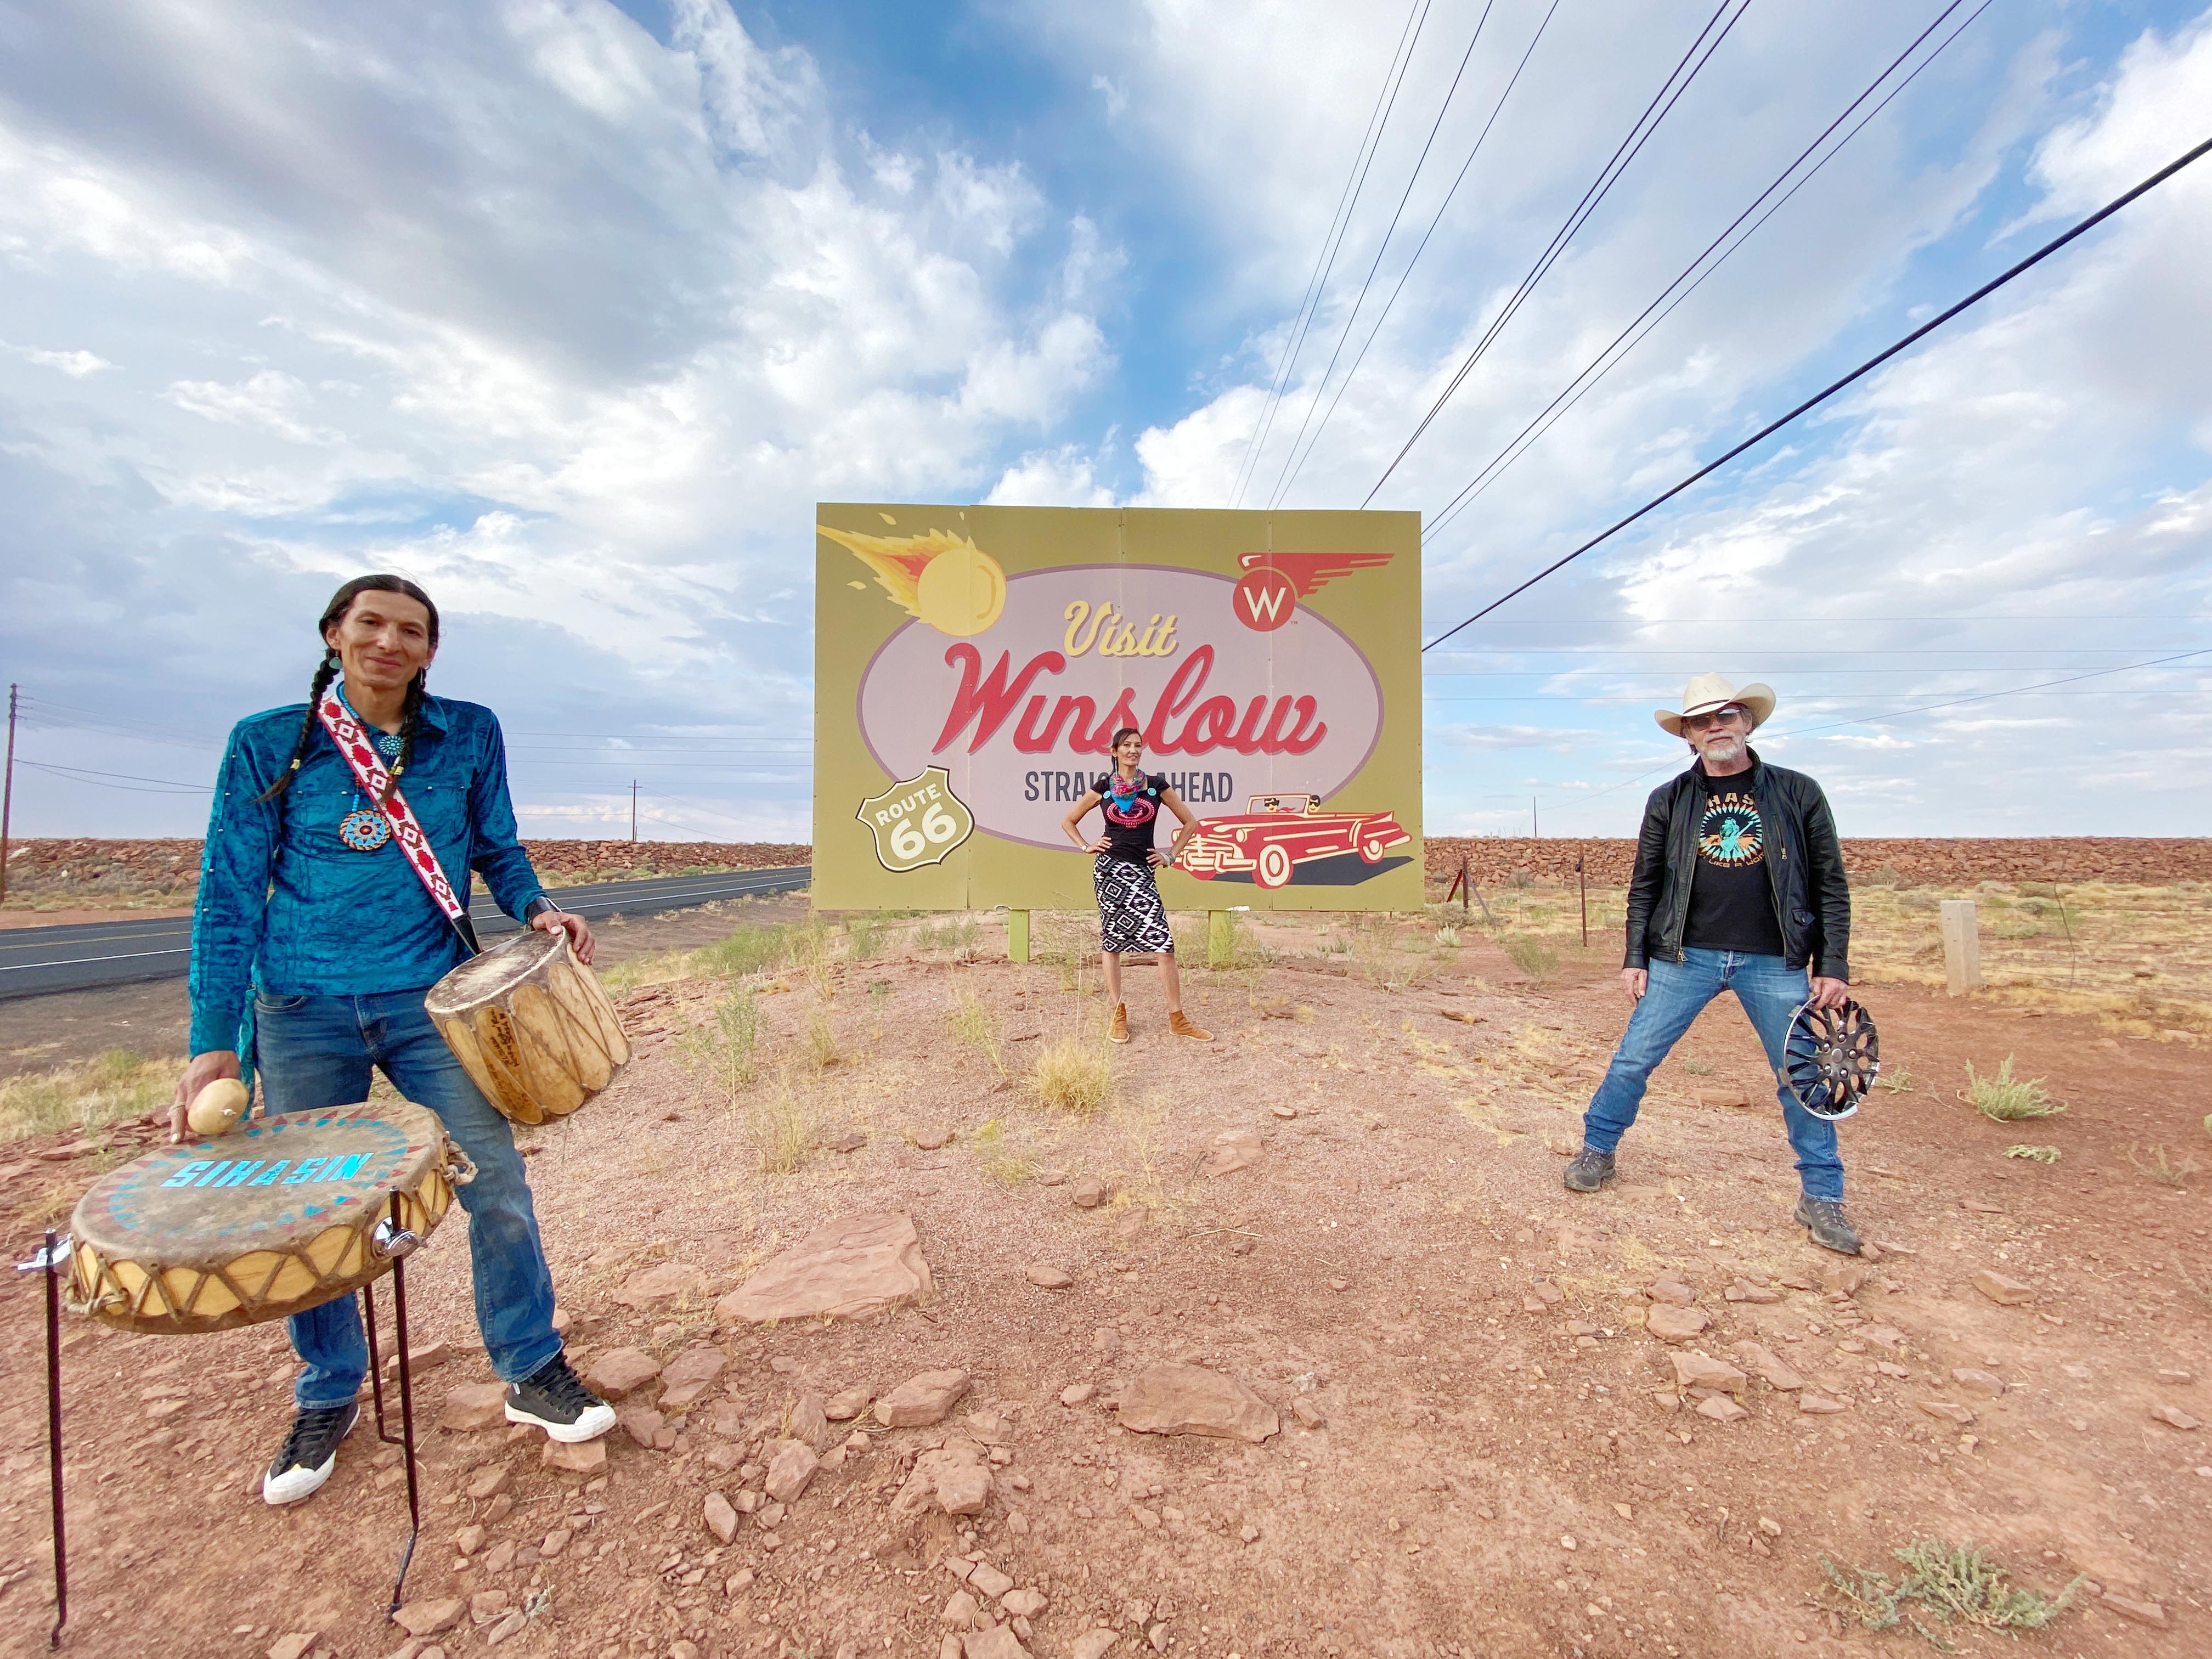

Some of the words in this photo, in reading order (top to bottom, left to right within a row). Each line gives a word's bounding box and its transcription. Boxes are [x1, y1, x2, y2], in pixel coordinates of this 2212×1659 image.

[1243, 585, 1286, 623] W
[1064, 600, 1178, 657] Visit
[932, 643, 1328, 755] Winslow
[875, 783, 941, 826] ROUTE
[1024, 771, 1109, 802] STRAI
[890, 802, 957, 860] 66
[160, 1152, 374, 1188] SIHASIN
